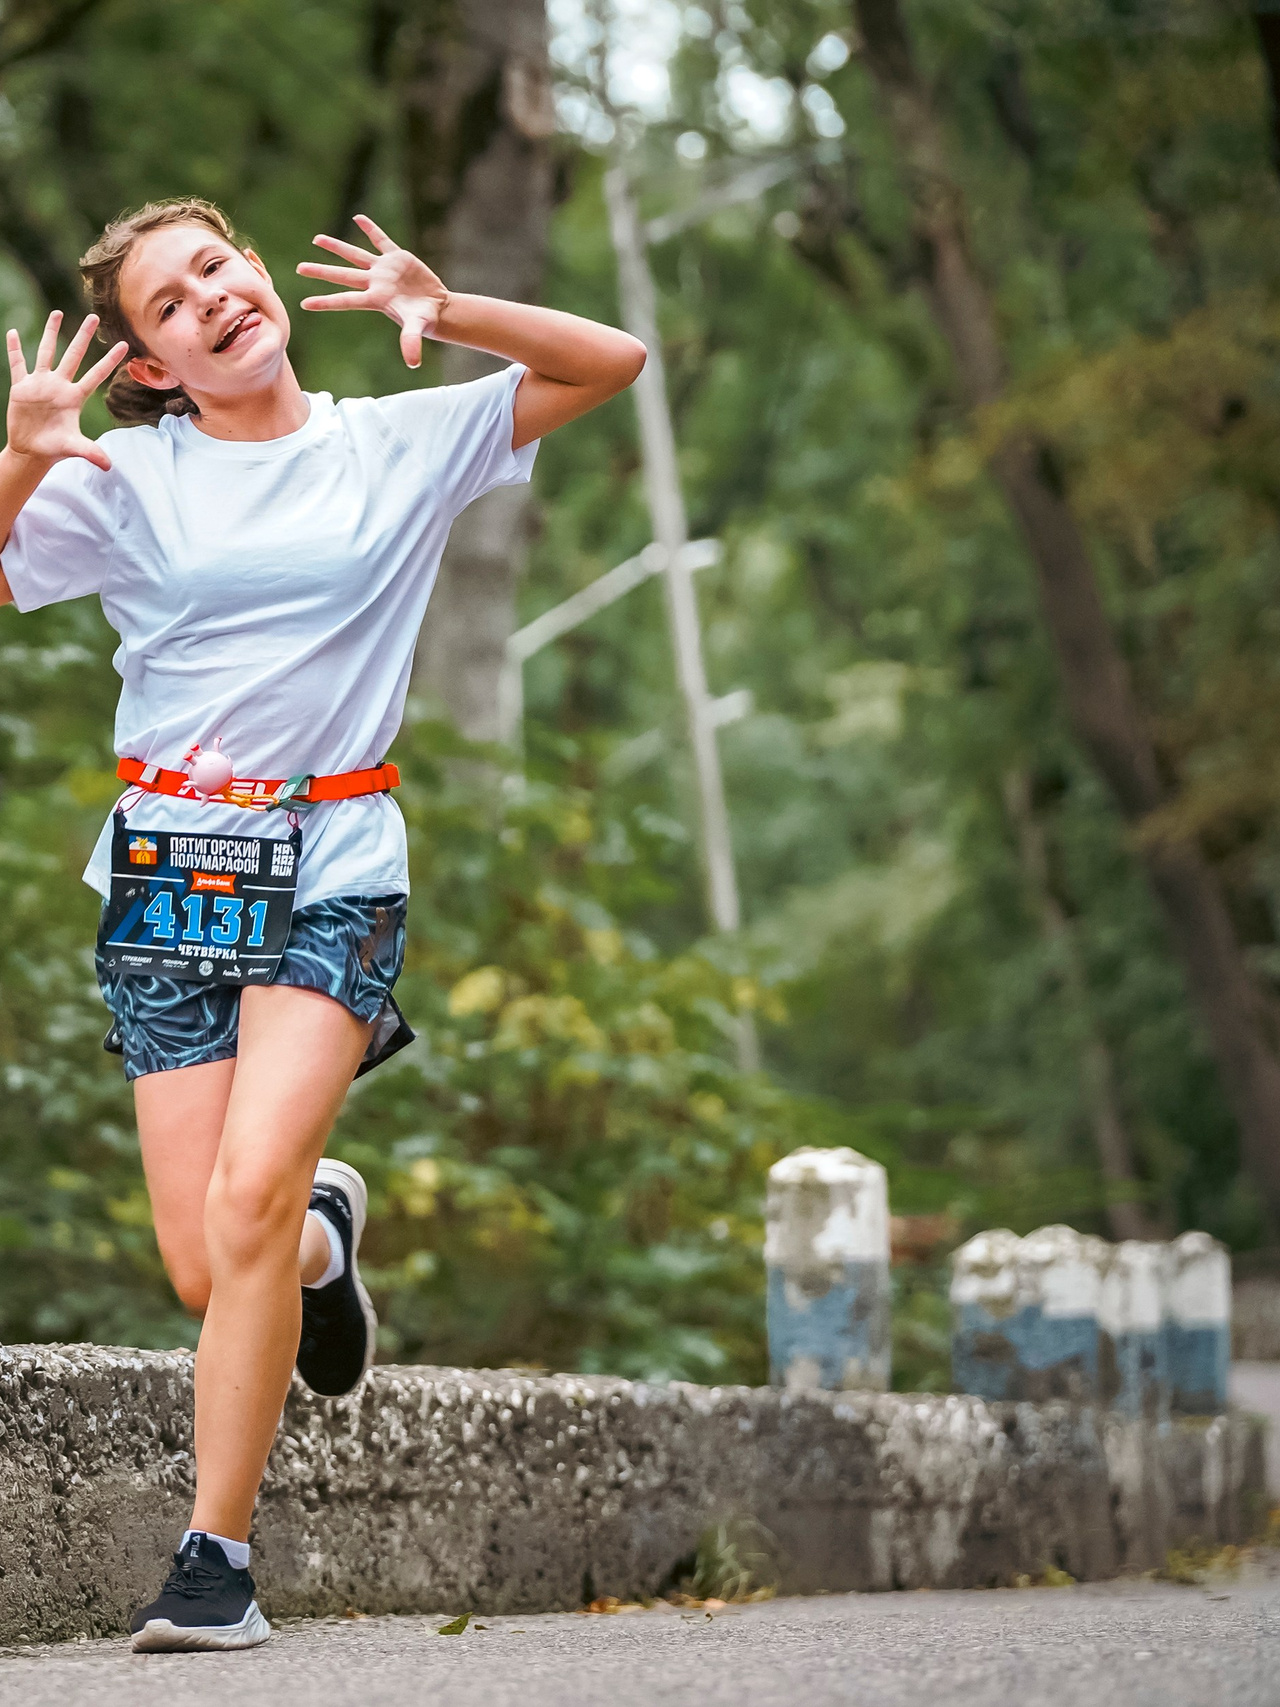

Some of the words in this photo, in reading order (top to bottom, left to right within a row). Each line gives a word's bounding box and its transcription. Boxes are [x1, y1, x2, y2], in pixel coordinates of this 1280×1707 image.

[170, 836, 261, 859] ПЯТИГОРСКИЙ
[170, 852, 260, 875] ПОЛУМАРАФОН
[271, 865, 293, 877] RUN
[143, 891, 269, 947] 4131
[178, 943, 238, 961] ЧЕТВЁРКА
[190, 1534, 201, 1558] FILA
